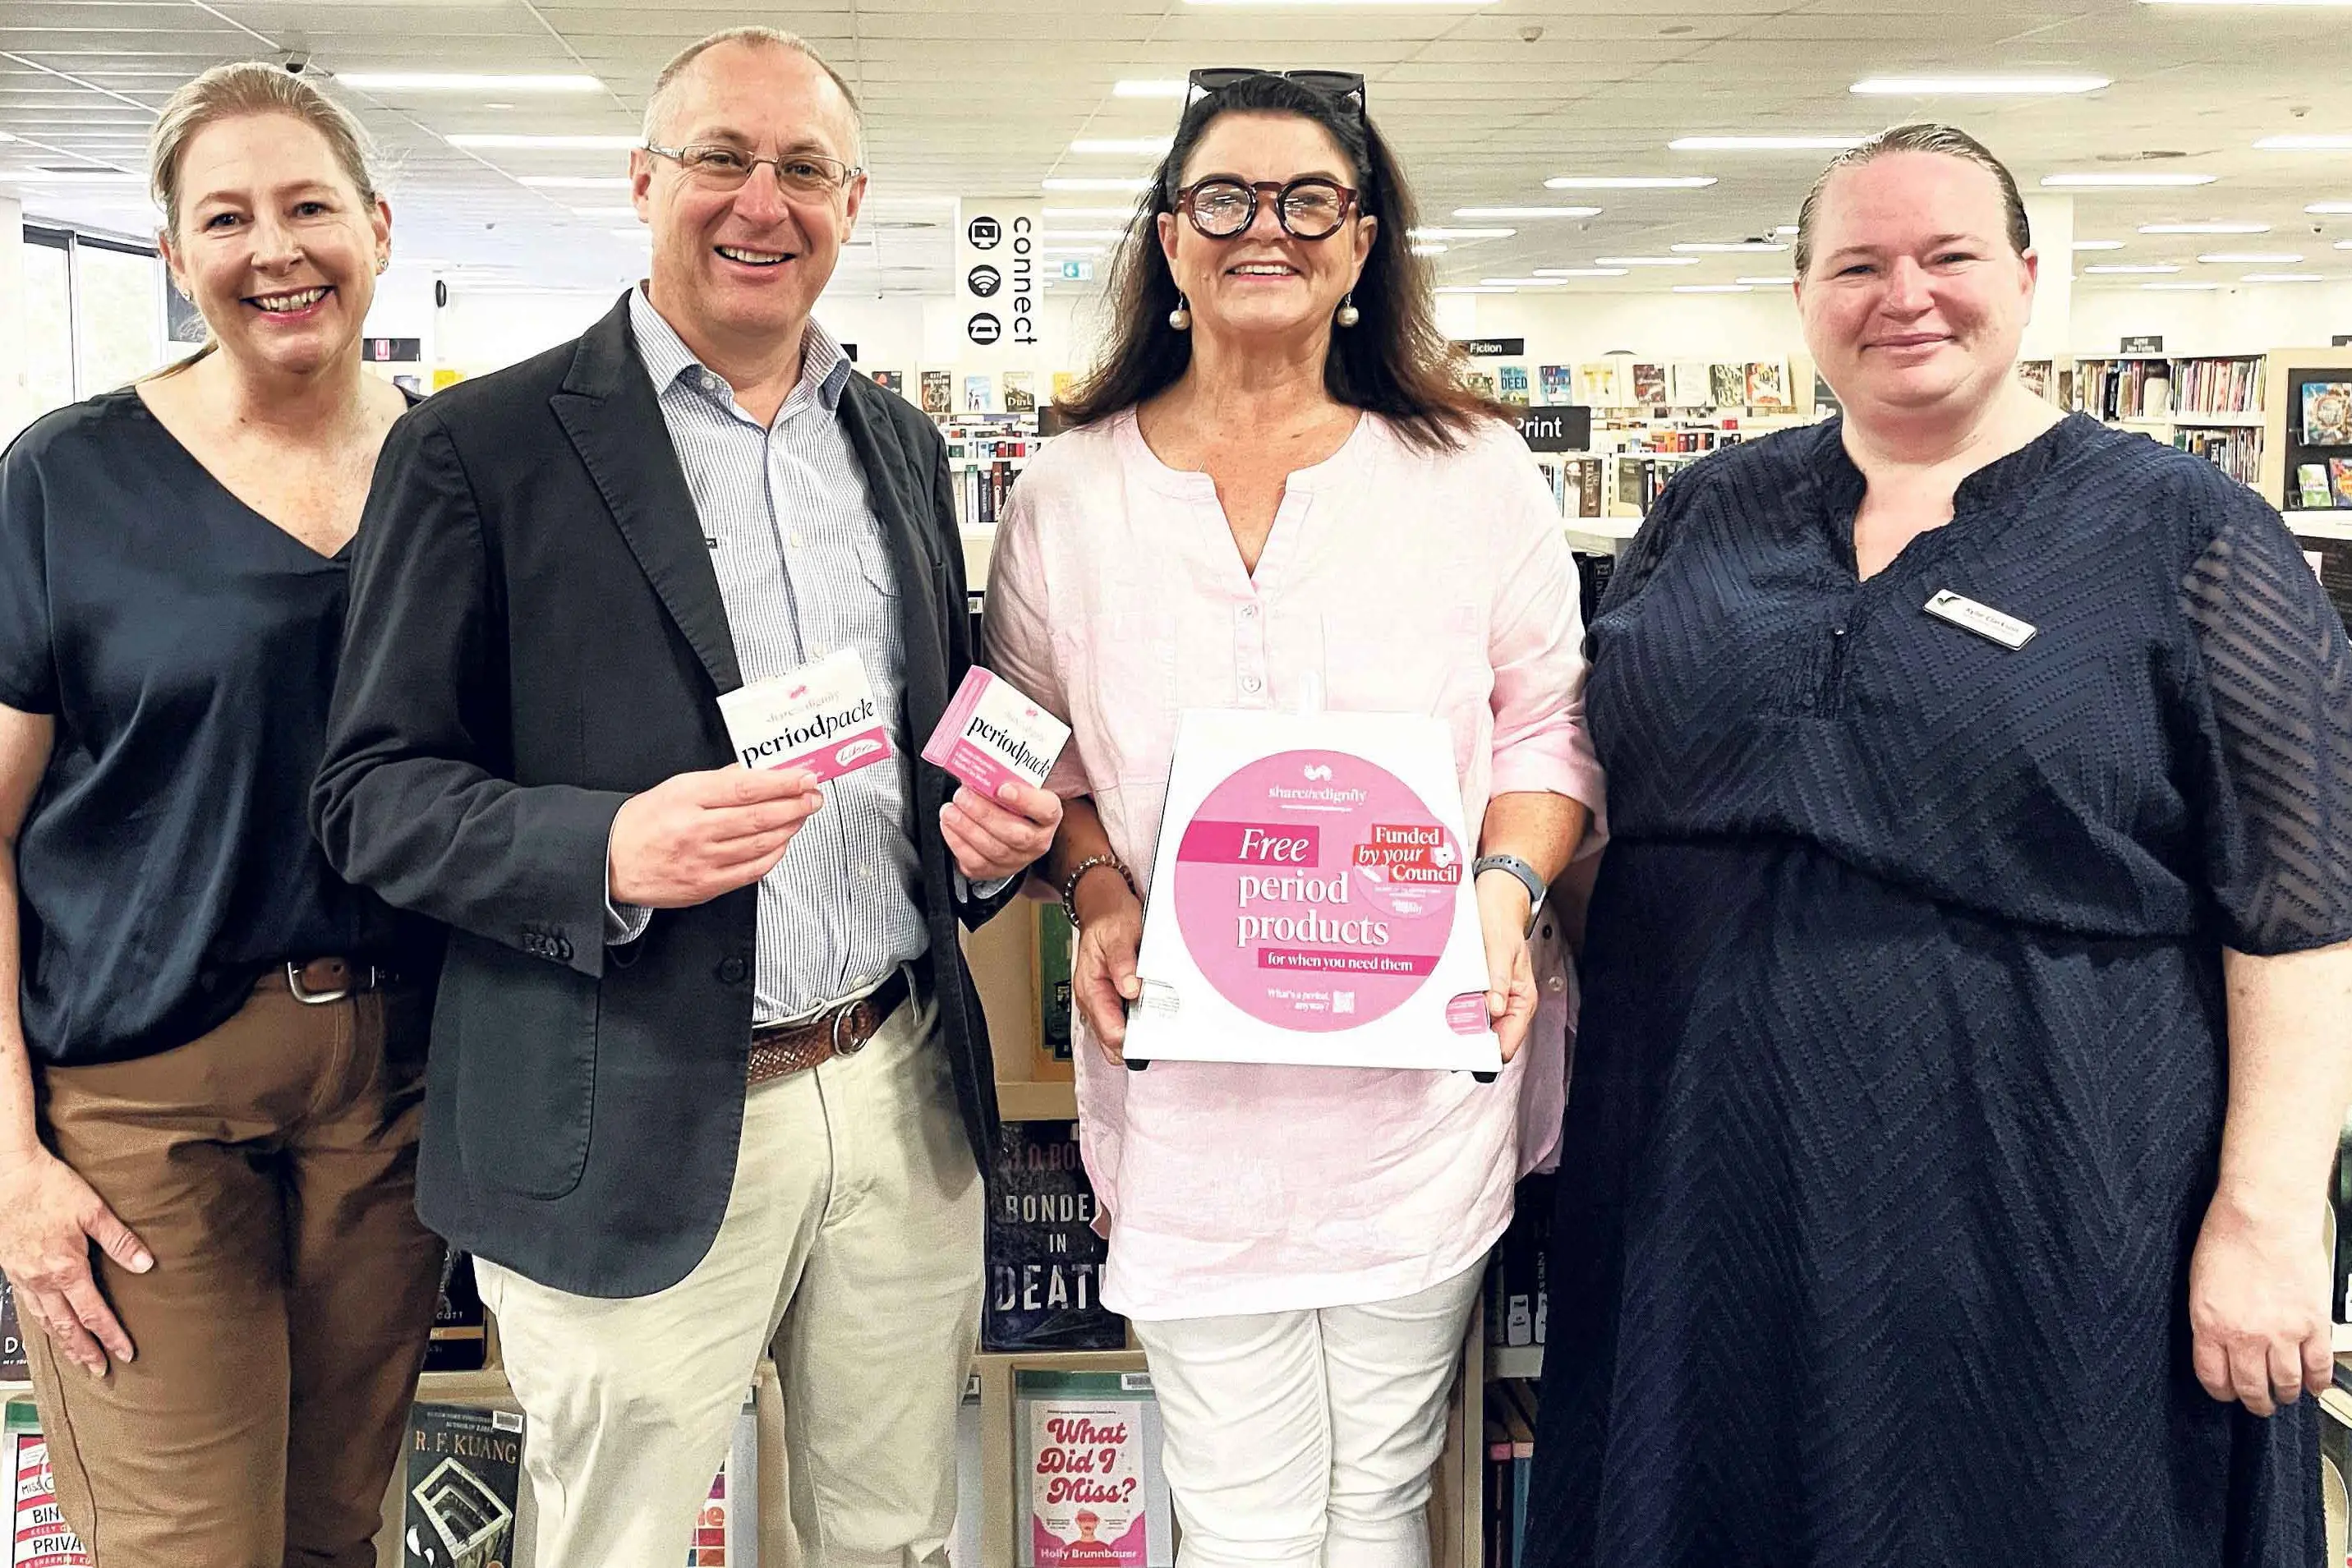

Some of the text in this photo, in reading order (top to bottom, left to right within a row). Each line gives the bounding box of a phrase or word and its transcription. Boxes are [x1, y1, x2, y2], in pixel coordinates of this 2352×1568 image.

[1014, 217, 1038, 344] connect
[1470, 343, 1503, 353] Fiction
[1502, 377, 1527, 389] DEED
[742, 698, 873, 769] periodpack
[967, 716, 1050, 778] periodpack
[1238, 828, 1309, 862] Free
[1375, 827, 1439, 844] Funded
[1358, 845, 1424, 867] by your
[1392, 864, 1457, 881] Council
[1238, 869, 1349, 907] period
[1237, 909, 1389, 947] products
[1268, 952, 1413, 972] for when you need them
[1006, 1193, 1090, 1222] BONDE
[1049, 1234, 1066, 1253] IN
[1047, 1419, 1128, 1444] What
[416, 1430, 517, 1464] R. F. KUANG
[1037, 1448, 1116, 1474] Did I
[1047, 1478, 1137, 1504] Miss?
[33, 1506, 60, 1524] BIN
[34, 1536, 82, 1554] PRIVA
[1041, 1548, 1069, 1561] Holly
